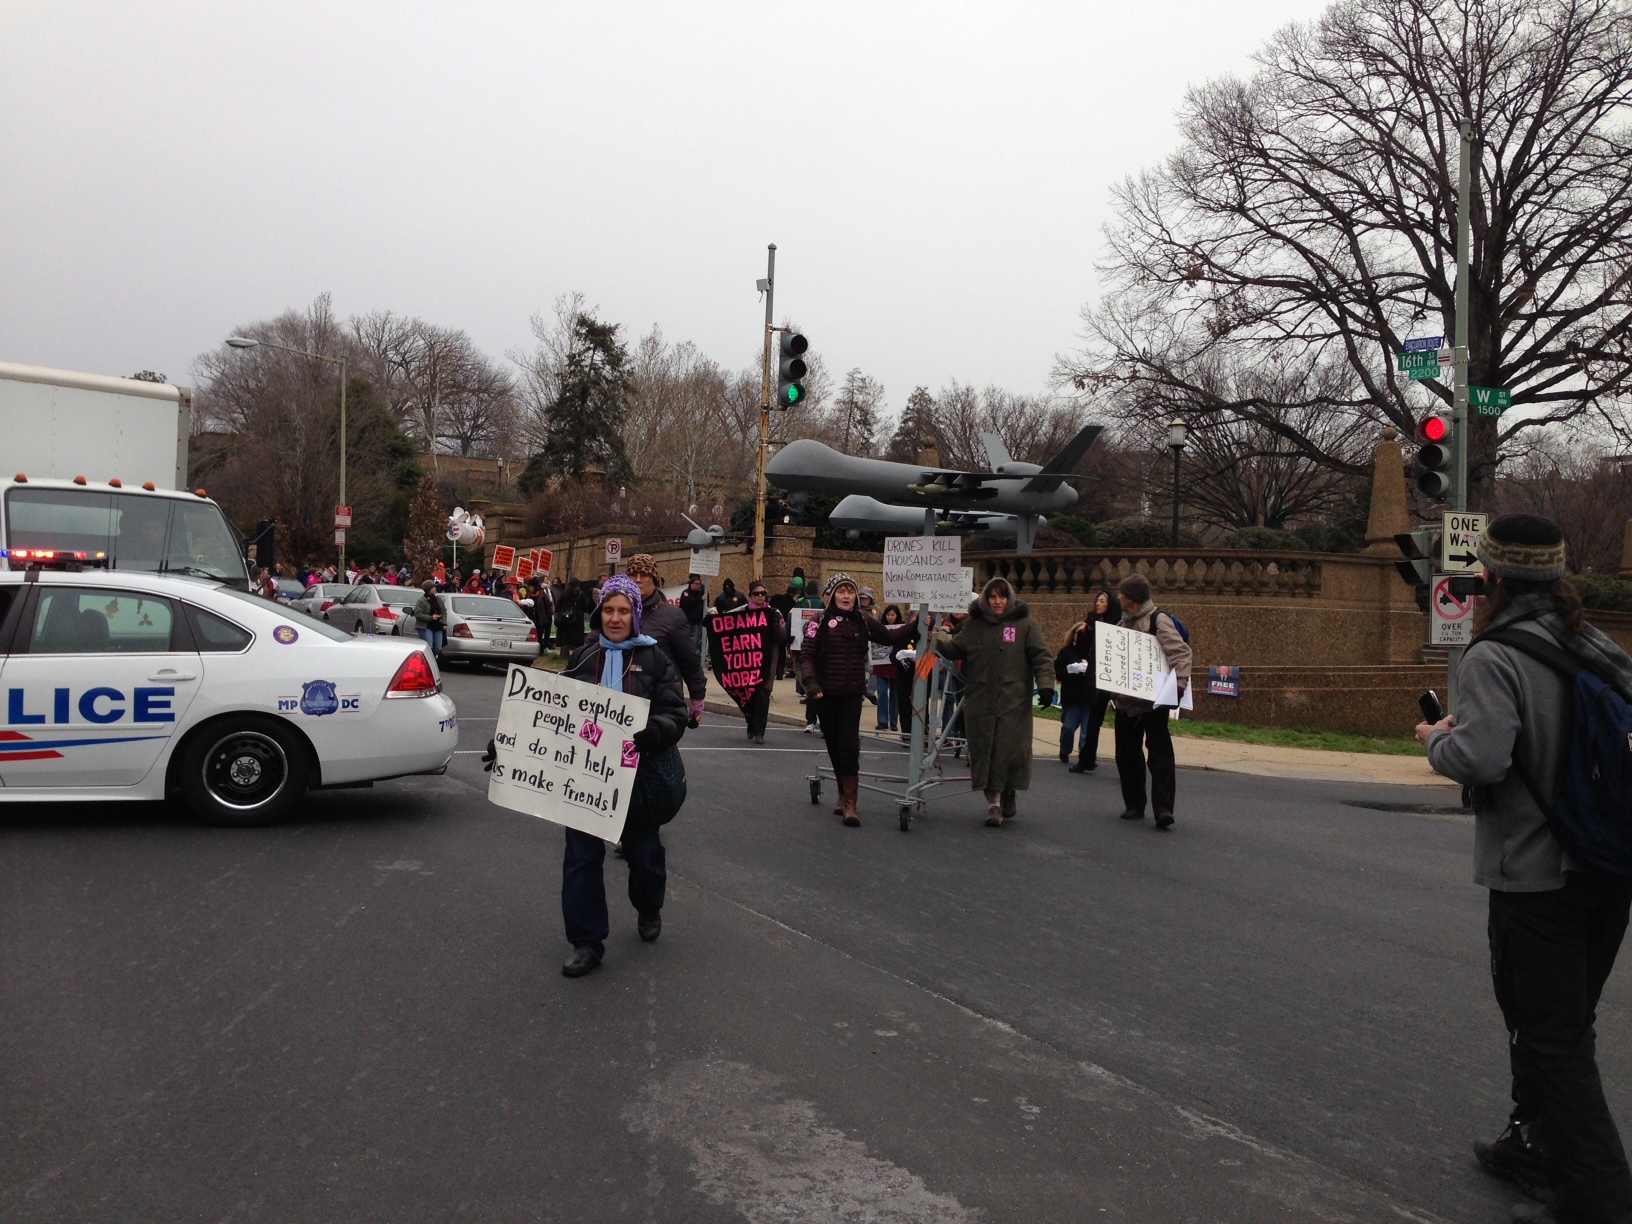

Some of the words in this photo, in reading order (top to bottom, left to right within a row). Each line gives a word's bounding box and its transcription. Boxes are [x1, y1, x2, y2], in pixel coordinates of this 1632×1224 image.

[1402, 354, 1423, 368] 16th
[1411, 367, 1438, 379] 2200
[1476, 389, 1490, 403] W
[1478, 405, 1500, 415] 1500
[1451, 517, 1480, 531] ONE
[887, 539, 924, 552] DRONES
[932, 540, 955, 552] KILL
[886, 554, 943, 566] THOUSANDS
[897, 590, 925, 599] REAPER
[712, 611, 768, 633] OBAMA
[1441, 623, 1462, 631] OVER
[721, 633, 762, 652] EARN
[1116, 630, 1126, 651] Cow?
[723, 651, 763, 670] YOUR
[721, 669, 763, 688] NOBEL
[1115, 653, 1127, 688] Sacred
[1145, 676, 1154, 692] 750
[8, 687, 176, 724] LICE
[278, 700, 298, 710] MP
[341, 699, 359, 709] DC
[508, 668, 570, 708] Drones
[578, 698, 634, 727] explode
[533, 710, 576, 735] people
[496, 732, 517, 748] and
[528, 738, 547, 755] do
[554, 745, 577, 765] not
[585, 749, 615, 783] help
[512, 767, 554, 792] make
[562, 778, 619, 818] friends!
